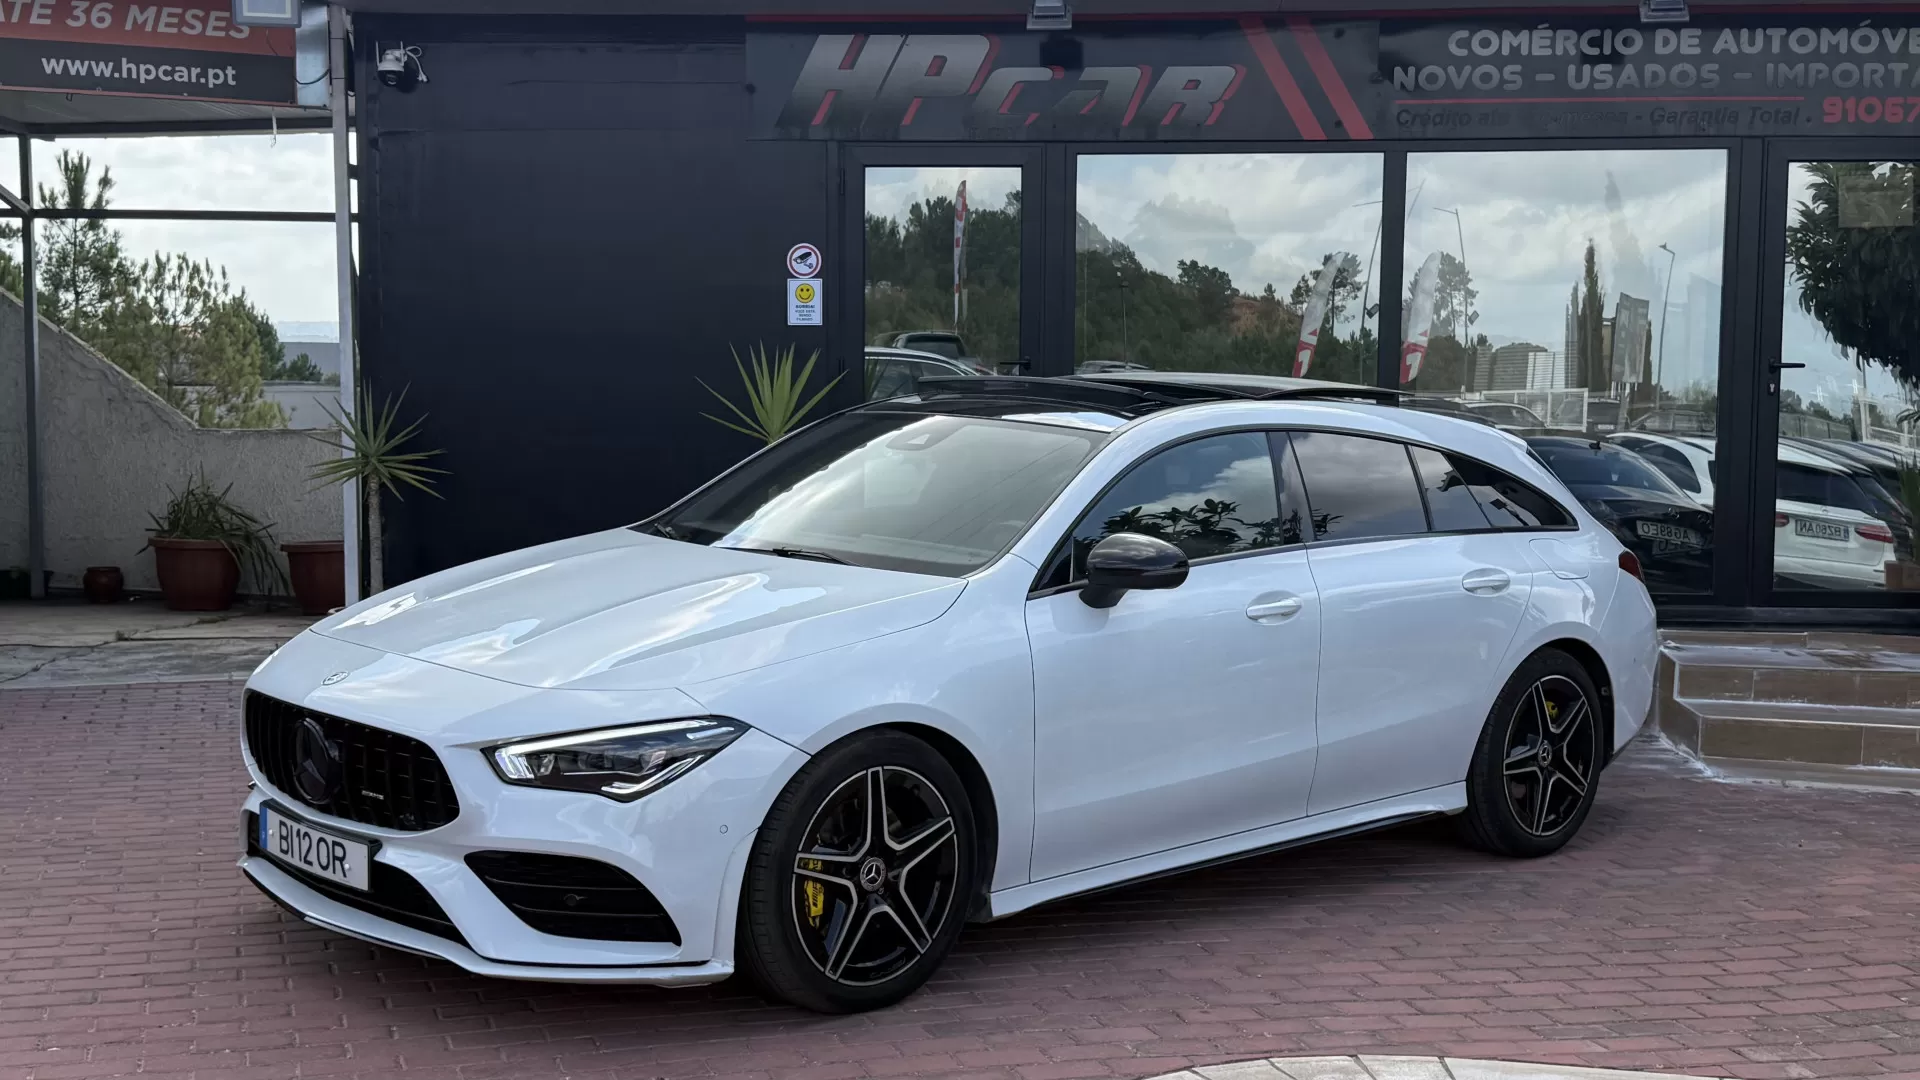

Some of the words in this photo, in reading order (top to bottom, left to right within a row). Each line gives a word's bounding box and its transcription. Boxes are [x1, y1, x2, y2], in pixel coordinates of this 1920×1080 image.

[0, 0, 56, 25] TE
[65, 1, 113, 29] 36
[1448, 23, 1643, 56] COMÉRCIO
[1654, 28, 1702, 55] DE
[41, 57, 237, 88] www.hpcar.pt
[1393, 64, 1523, 92] NOVOS
[1567, 62, 1720, 90] USADOS
